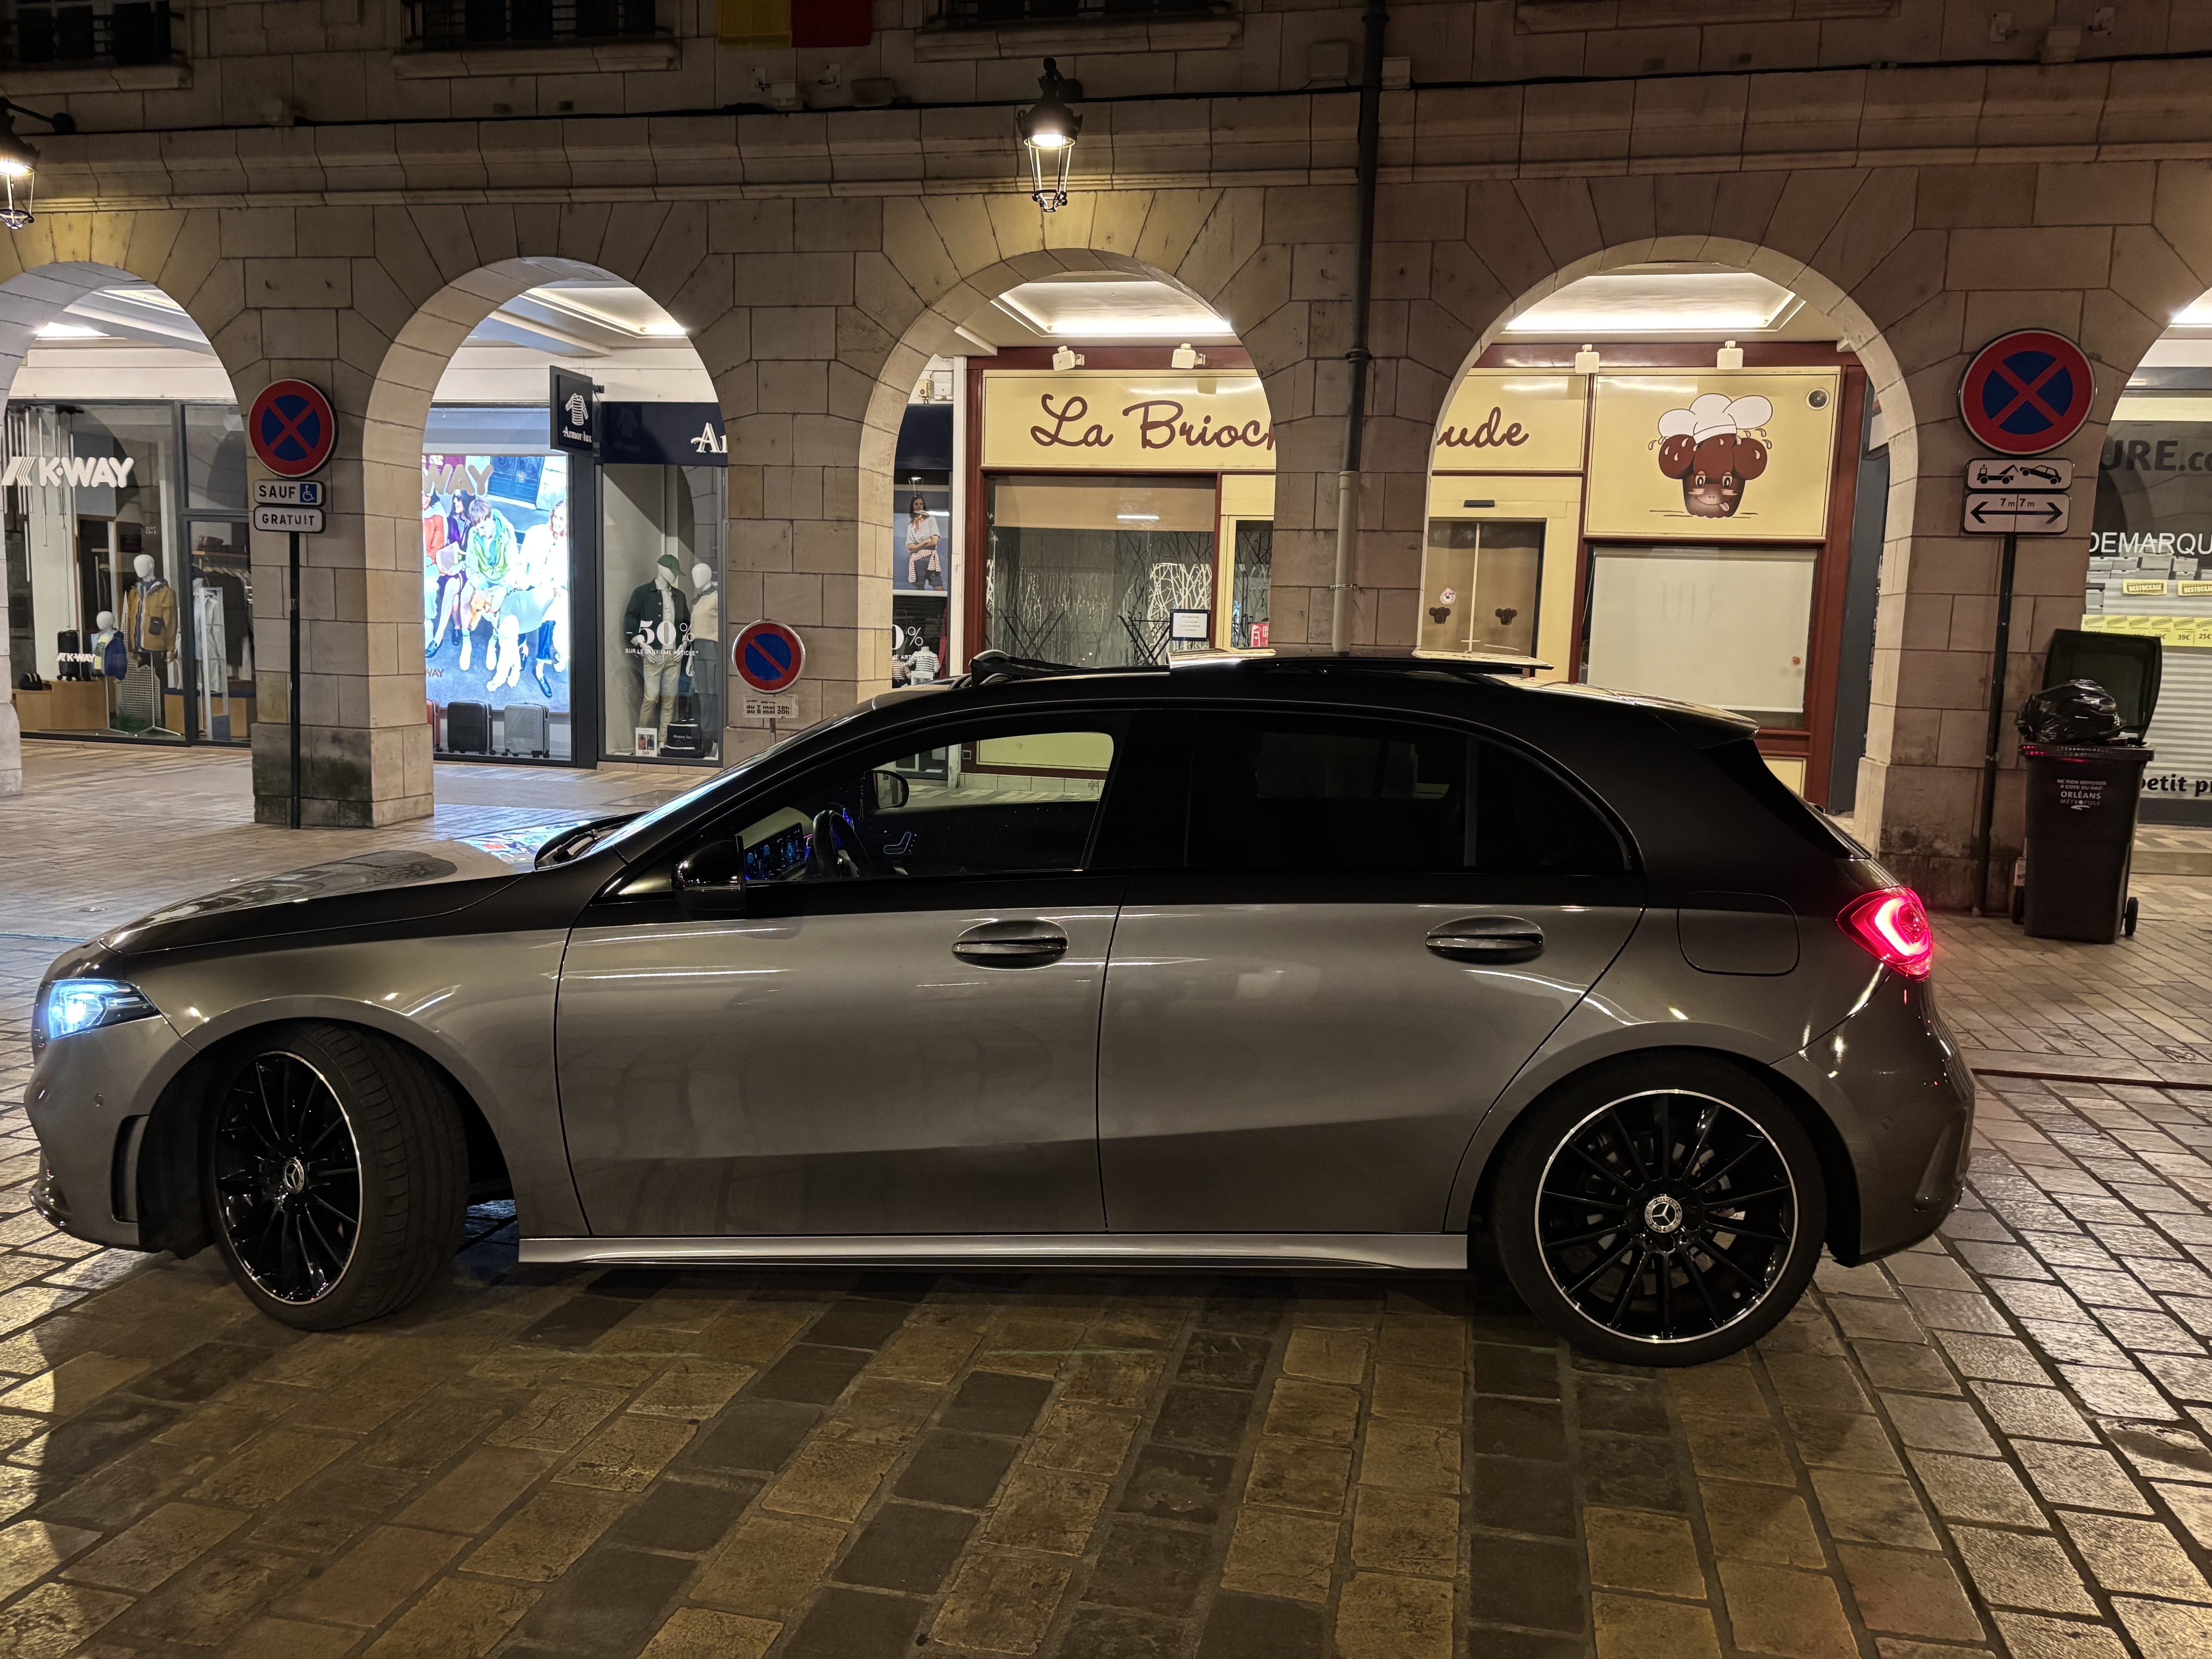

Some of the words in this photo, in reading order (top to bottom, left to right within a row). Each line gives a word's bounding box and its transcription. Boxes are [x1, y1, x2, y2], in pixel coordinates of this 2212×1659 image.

[1030, 393, 1113, 447] La
[259, 485, 295, 498] SAUF
[2001, 498, 2006, 507] 7
[2020, 498, 2026, 507] 7
[262, 514, 314, 526] GRATUIT
[2142, 774, 2187, 792] etit
[2195, 780, 2212, 797] p
[2061, 790, 2101, 799] ORLÉANS
